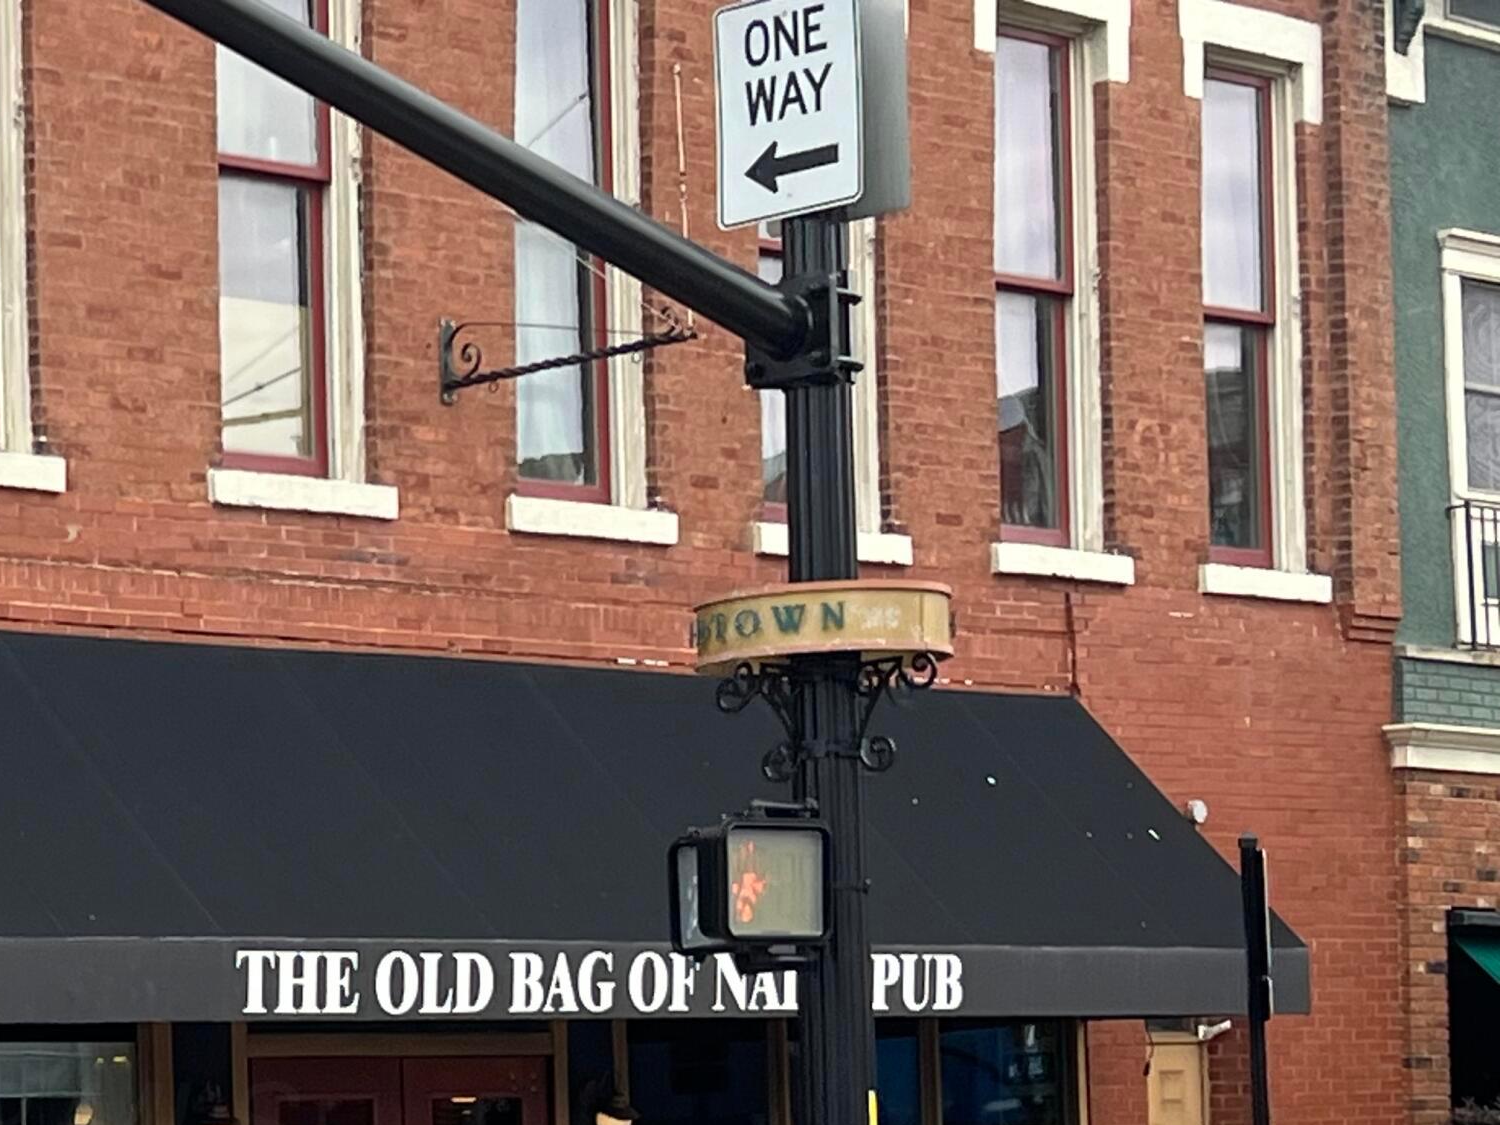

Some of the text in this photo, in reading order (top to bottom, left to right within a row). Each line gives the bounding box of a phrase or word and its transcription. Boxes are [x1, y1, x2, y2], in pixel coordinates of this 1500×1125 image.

[744, 4, 828, 67] ONE
[745, 63, 832, 126] WAY
[697, 601, 846, 646] TOWN
[236, 951, 963, 1015] THE OLD BAG OF NAI PUB
